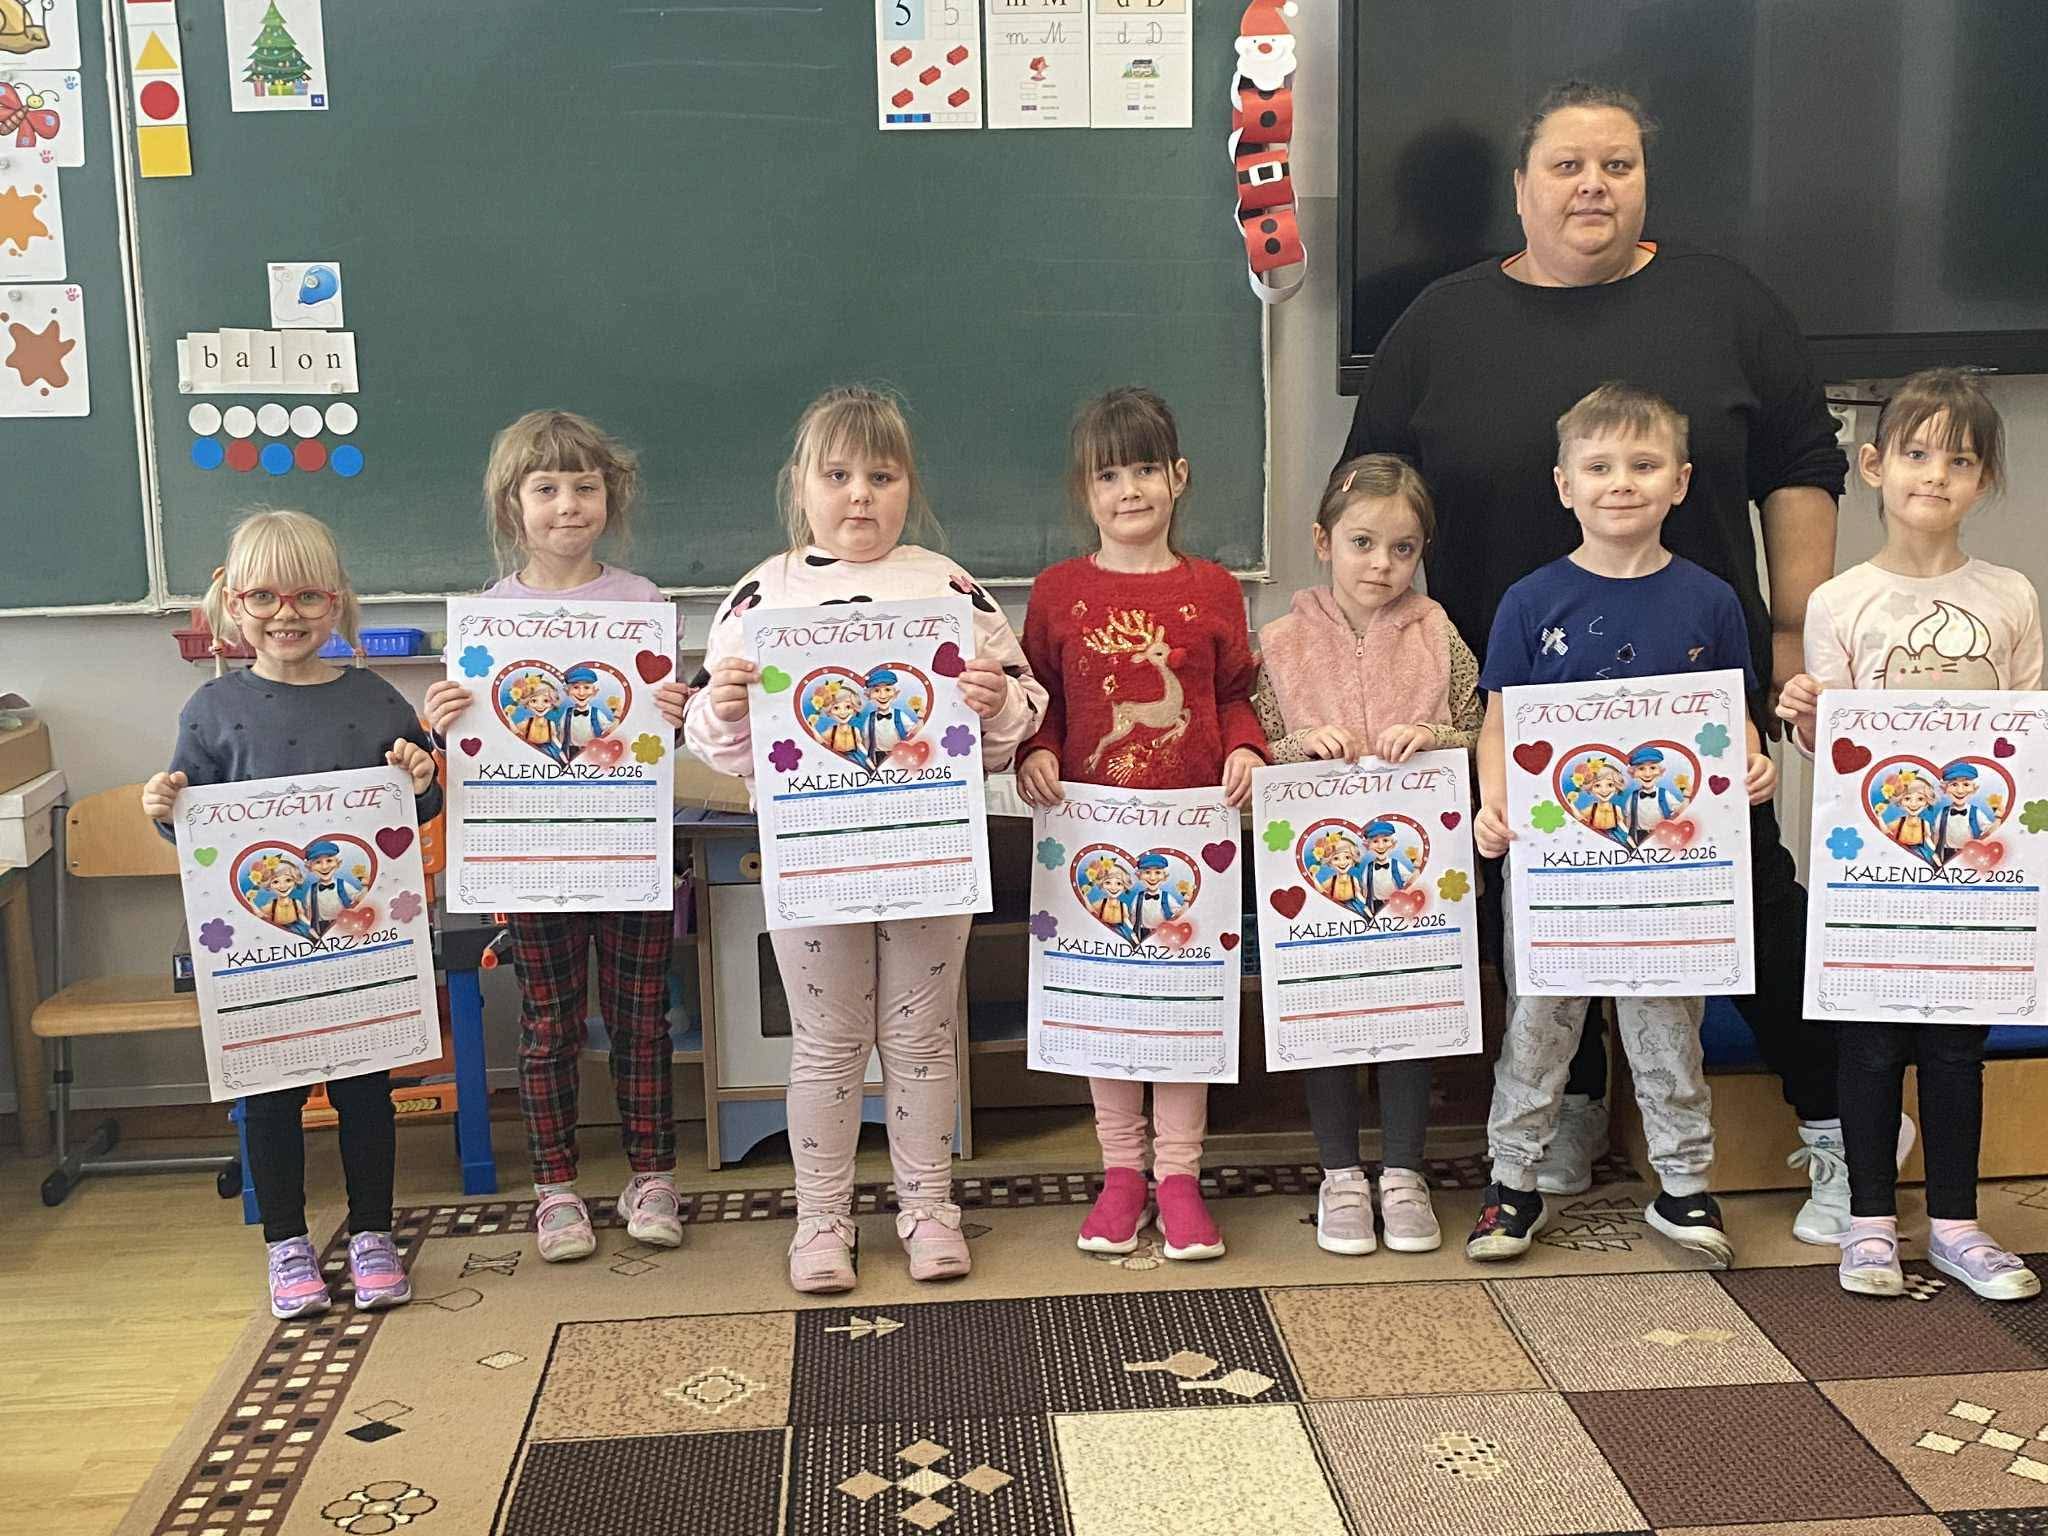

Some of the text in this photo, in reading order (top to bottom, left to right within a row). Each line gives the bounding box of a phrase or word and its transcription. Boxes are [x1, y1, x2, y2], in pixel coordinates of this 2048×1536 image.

[895, 0, 912, 26] 5
[1006, 21, 1066, 45] m M
[1117, 21, 1163, 45] d D
[474, 616, 598, 640] KOCHAM
[771, 621, 895, 648] KOCHAM
[1531, 698, 1663, 724] KOCHAM
[1845, 709, 1979, 732] KOCHAM
[479, 763, 643, 780] KALENDARZ 2026
[788, 765, 952, 793] KALENDARZ 2026
[1277, 775, 1393, 802] KOCHAM
[203, 793, 333, 826] KOCHAM
[1056, 801, 1169, 827] KOCHAM
[1543, 845, 1717, 867] KALENDARZ 2026
[1844, 865, 2024, 885] KALENDARZ 2026
[1289, 913, 1446, 941] KALENDARZ 2026
[227, 927, 398, 969] KALENDARZ 2026
[1057, 936, 1211, 960] KALENDARZ 2026
